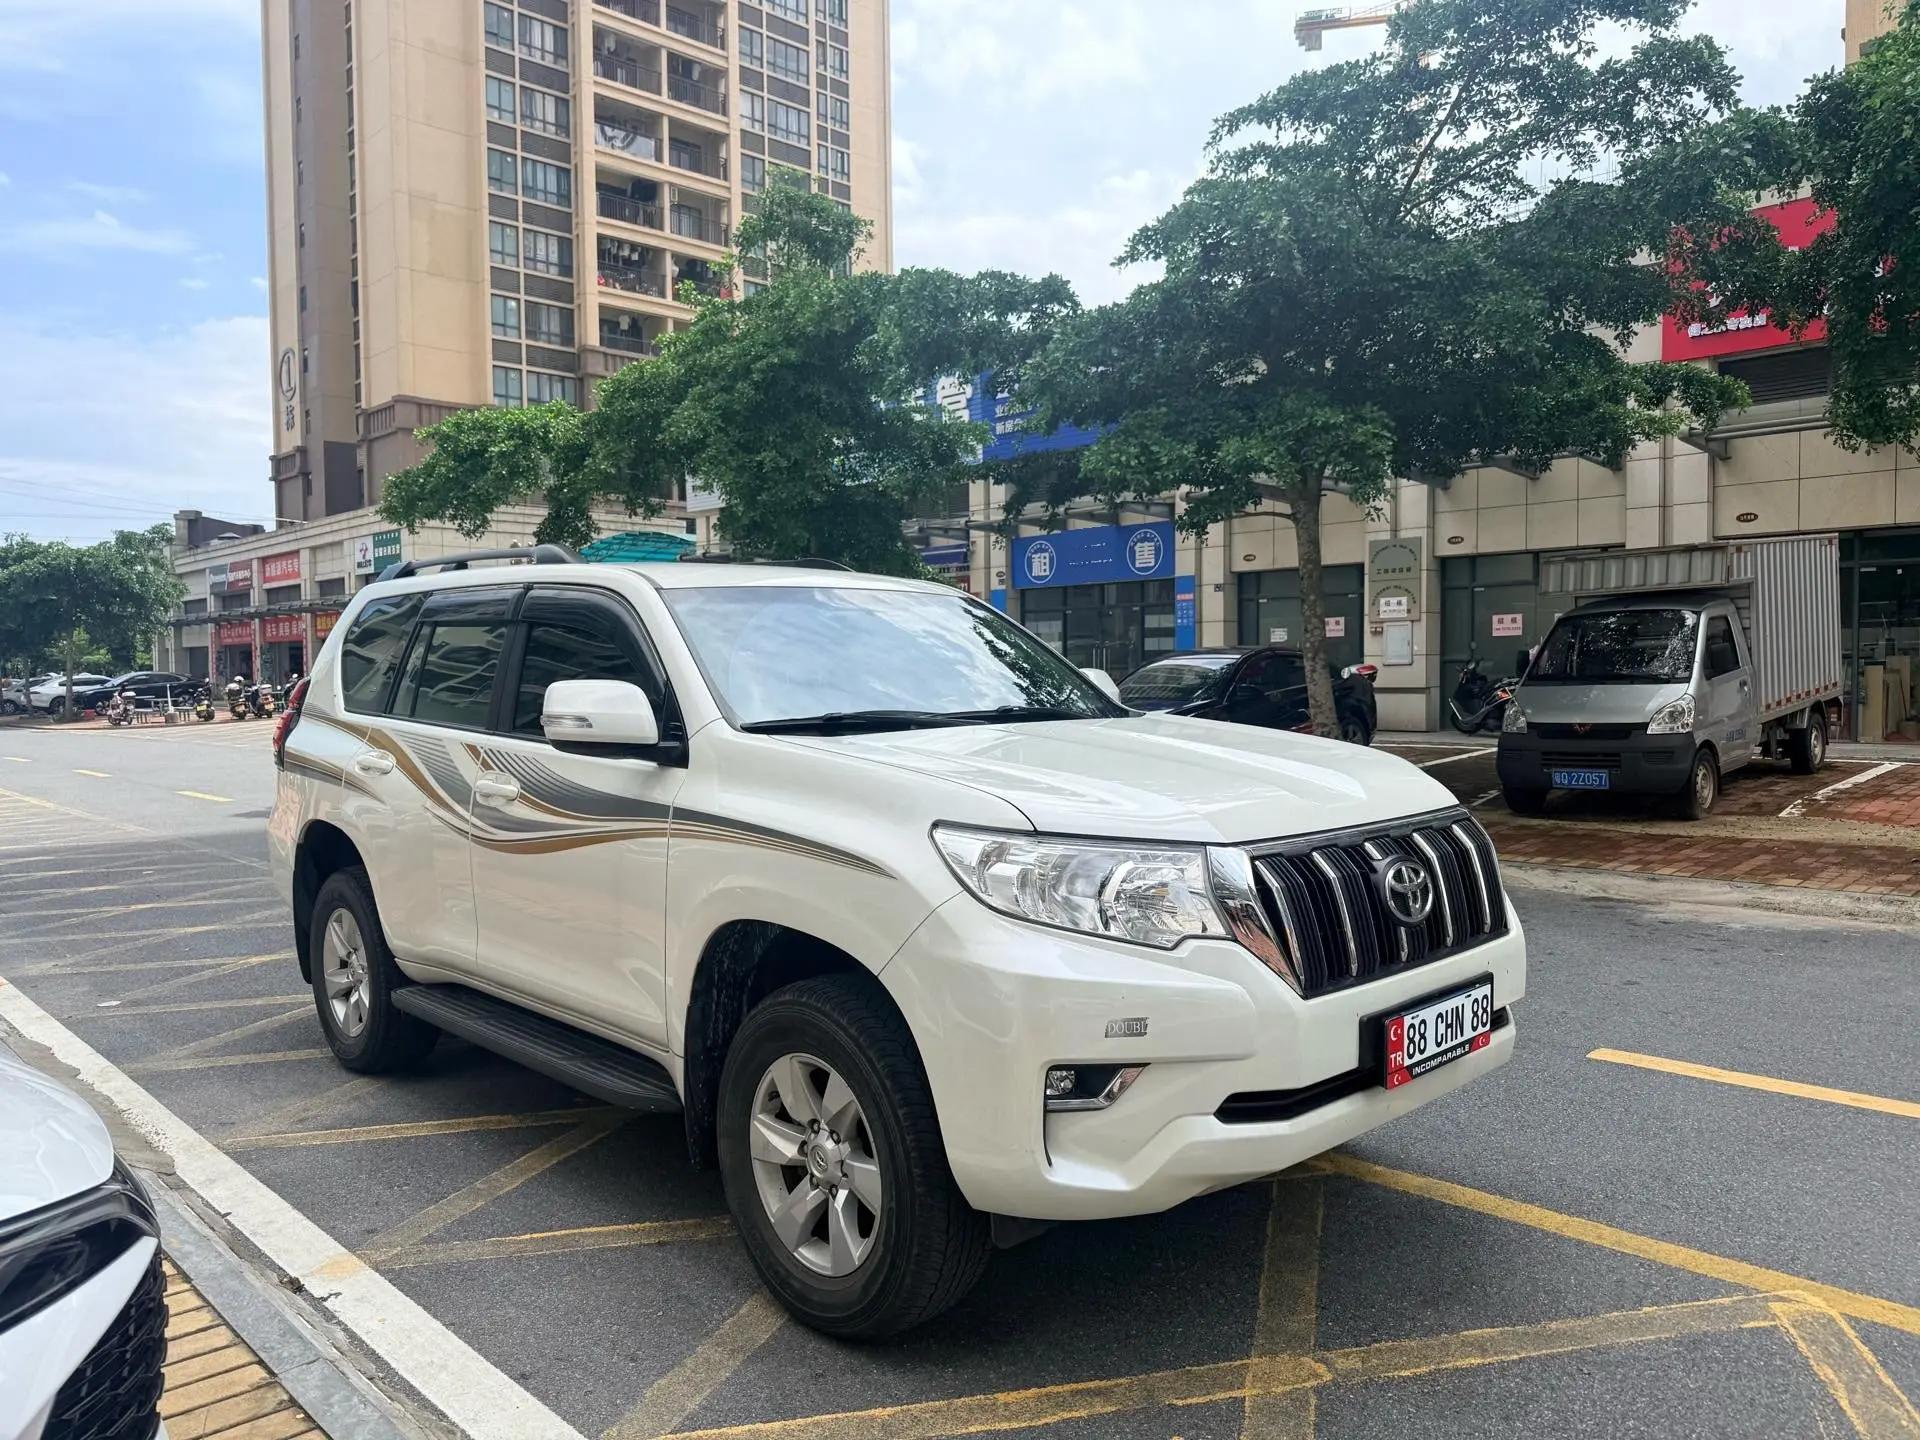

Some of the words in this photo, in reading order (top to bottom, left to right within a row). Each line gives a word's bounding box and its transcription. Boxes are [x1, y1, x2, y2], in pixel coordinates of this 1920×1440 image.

[1031, 552, 1050, 577] 租
[1134, 541, 1155, 568] 售
[1406, 1018, 1428, 1060] 88
[1434, 1003, 1465, 1048] CHN
[1471, 993, 1489, 1033] 88
[1390, 1051, 1403, 1069] TR
[1412, 1043, 1470, 1076] INCOMPARABLE
